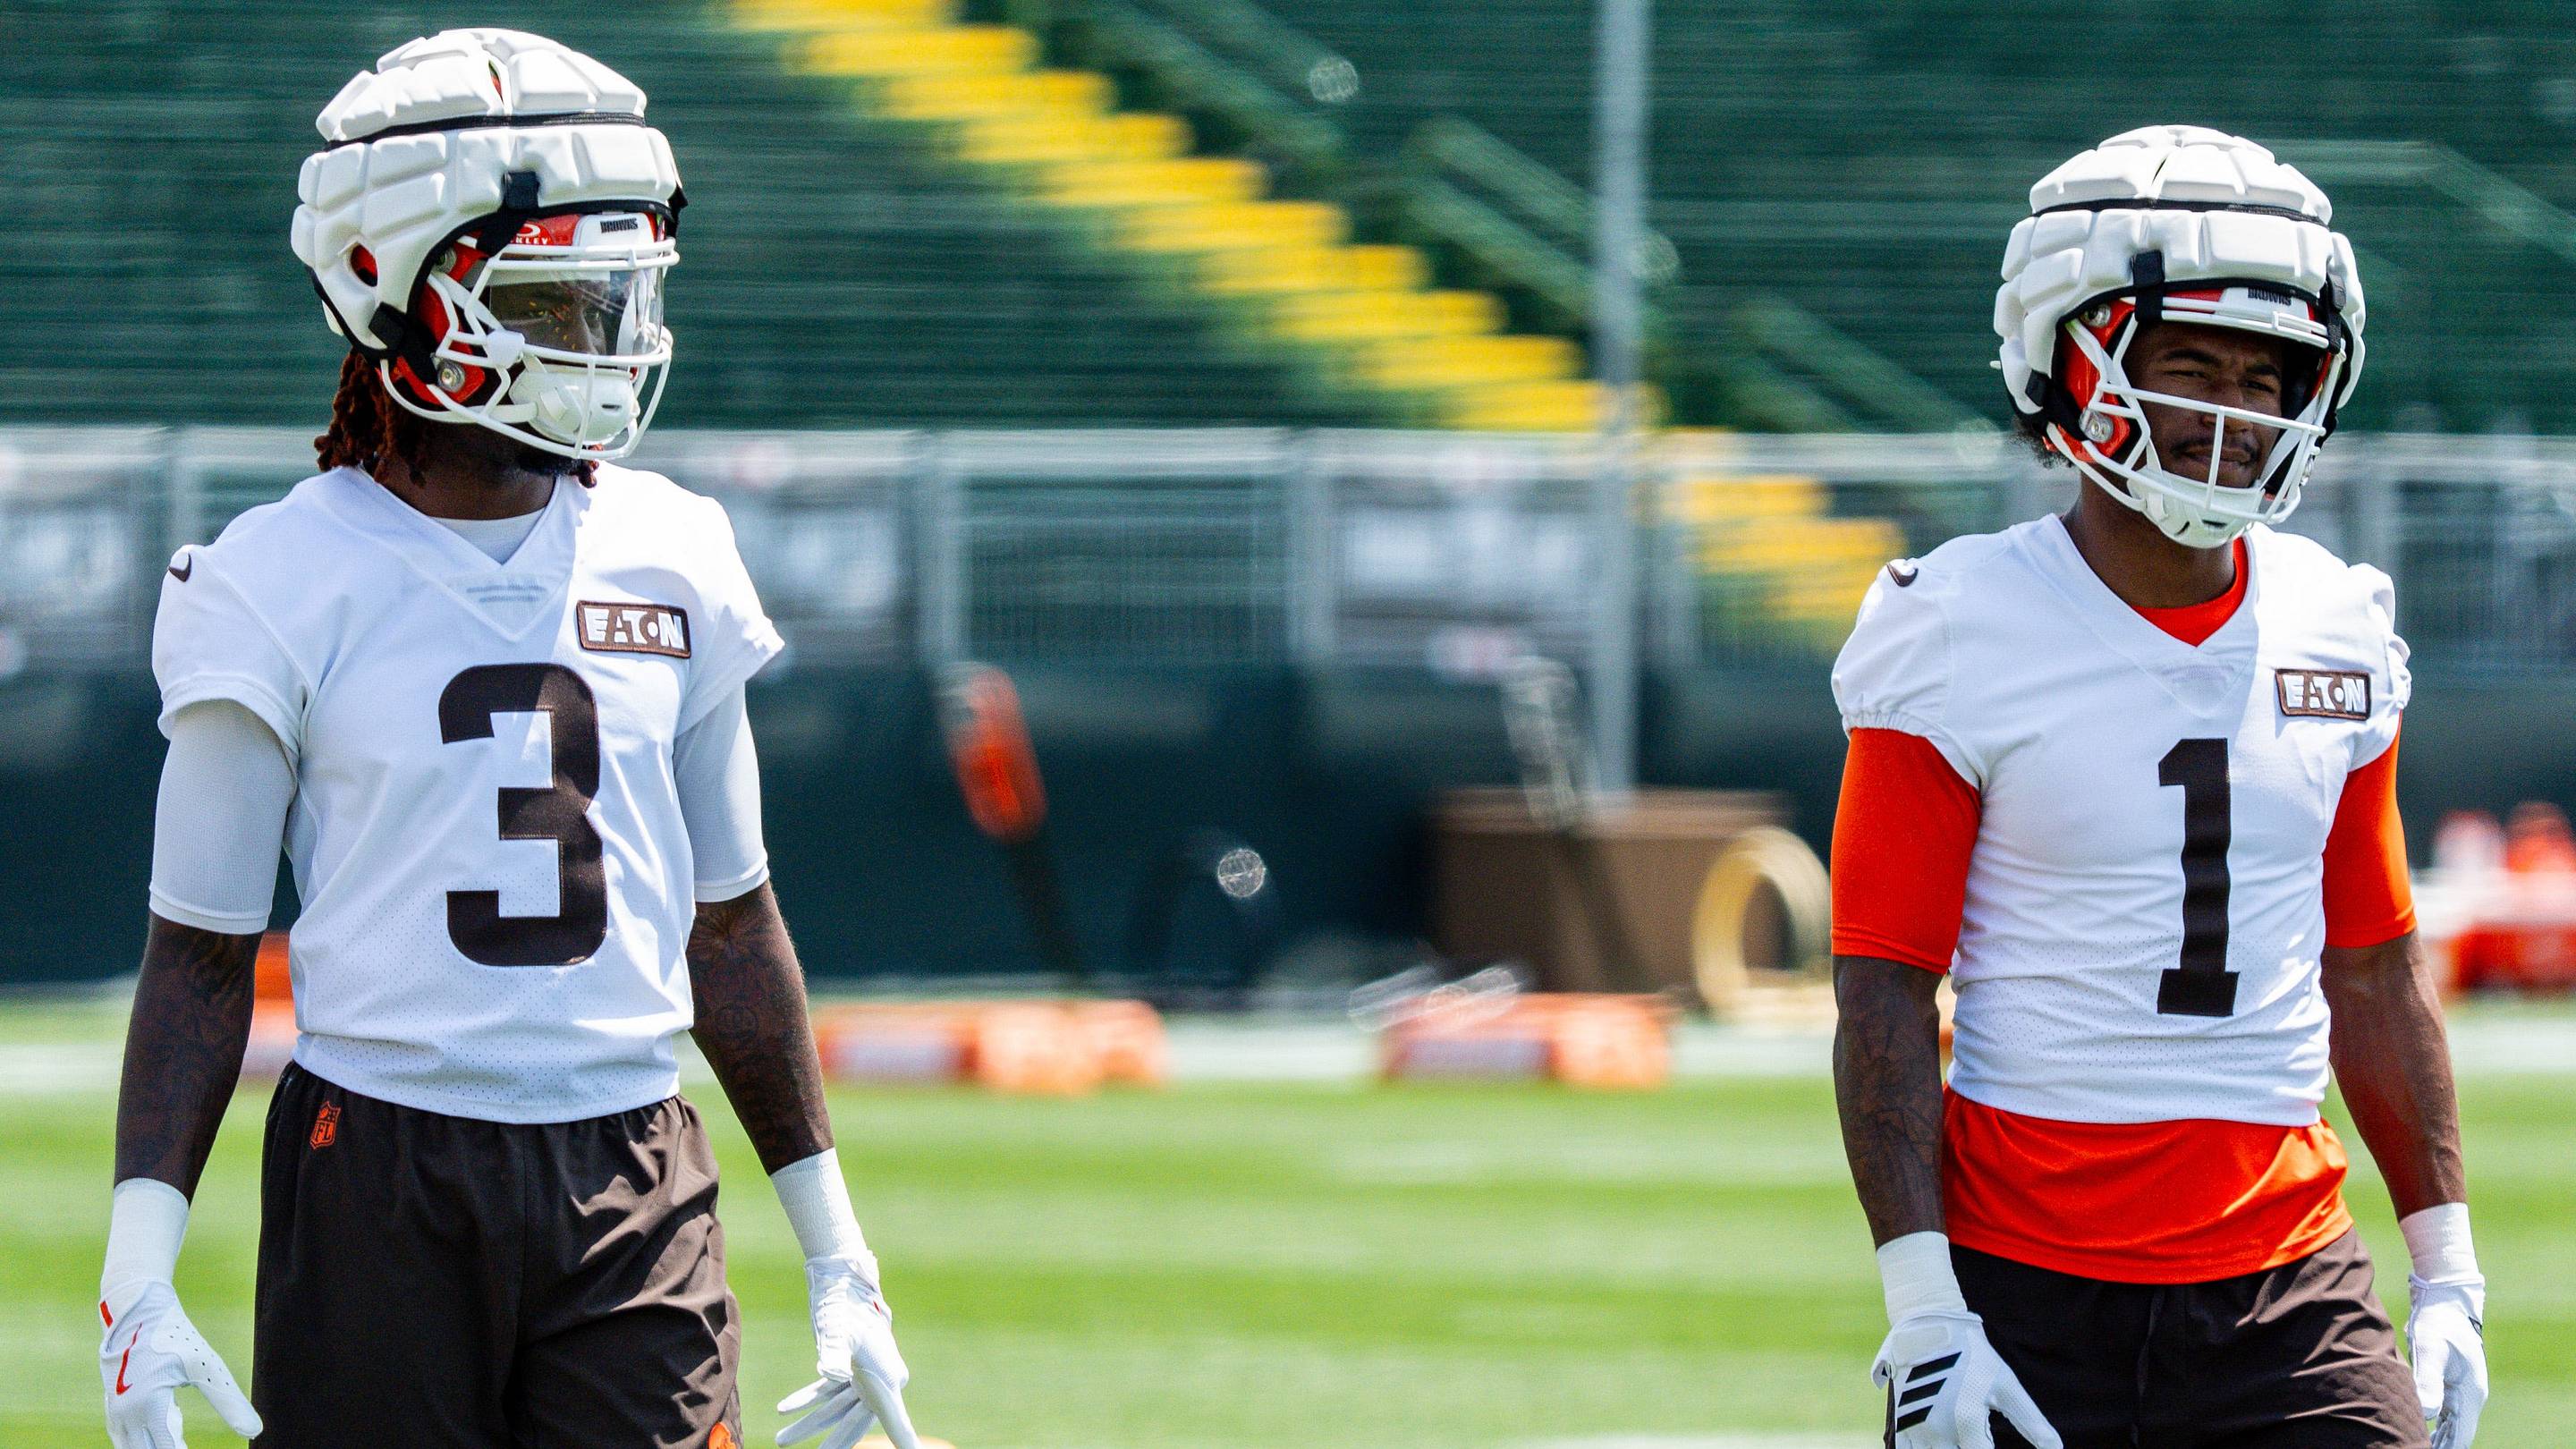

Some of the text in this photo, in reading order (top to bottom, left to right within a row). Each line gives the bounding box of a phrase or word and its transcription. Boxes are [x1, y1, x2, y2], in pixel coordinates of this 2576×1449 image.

[2247, 286, 2292, 306] BROWNS
[584, 607, 685, 650] EATON
[2283, 674, 2367, 713] EATON
[438, 663, 607, 967] 3
[2157, 738, 2240, 1017] 1
